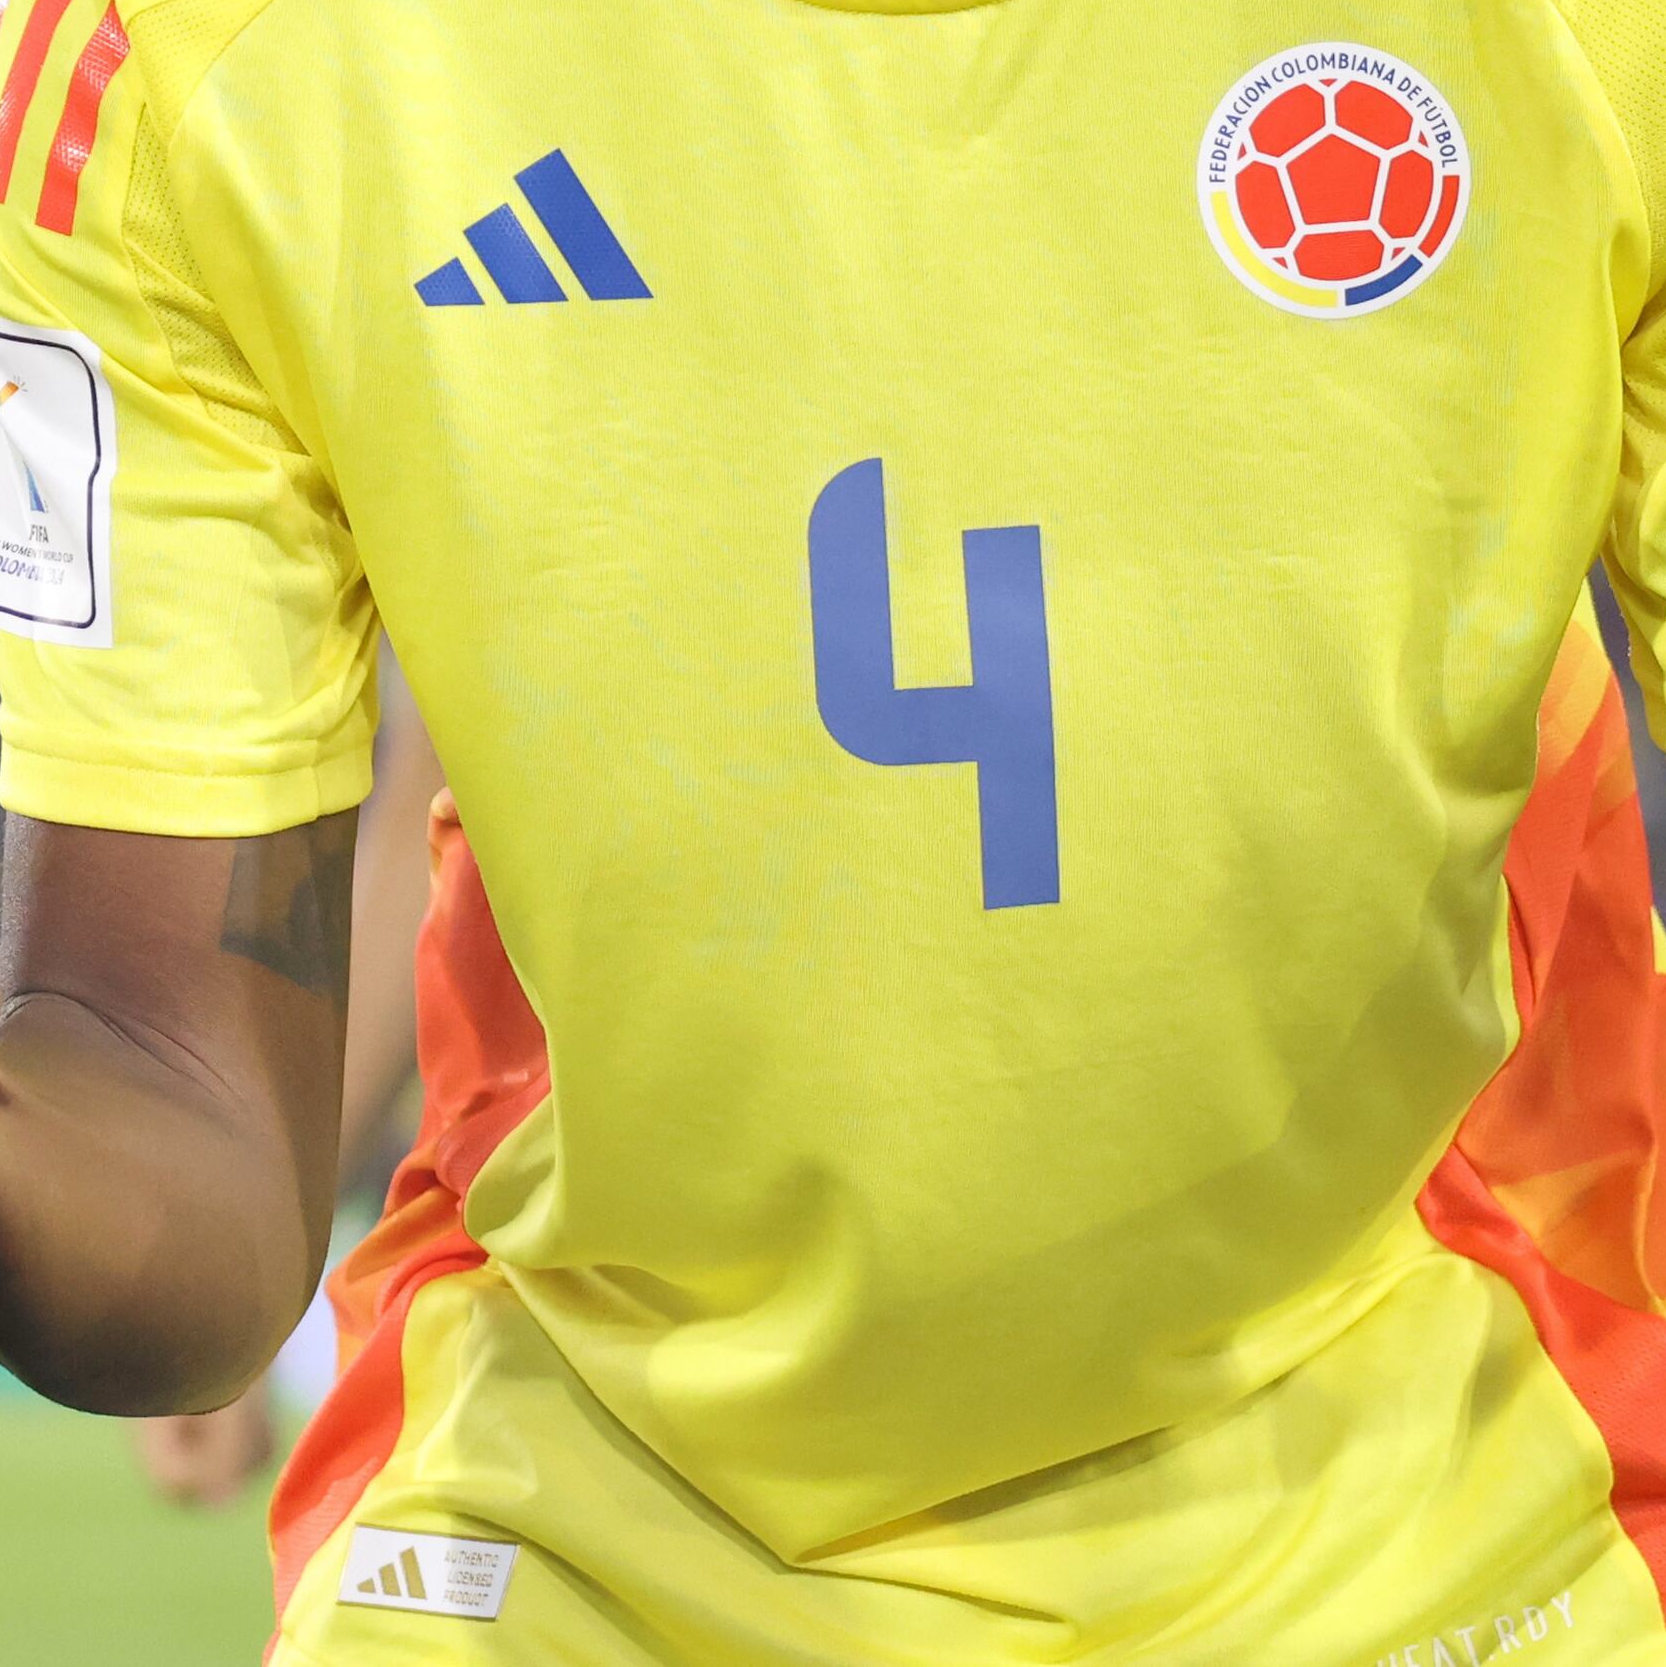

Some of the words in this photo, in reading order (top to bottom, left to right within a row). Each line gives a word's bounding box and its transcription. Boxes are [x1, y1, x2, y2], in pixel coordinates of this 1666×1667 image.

[1208, 74, 1273, 183] FEDERACIÓN
[1270, 51, 1396, 86] COLOMBIANA
[1396, 76, 1422, 102] DE
[1415, 96, 1459, 169] FÚTBOL
[28, 523, 50, 544] FIFA
[808, 457, 1060, 910] 4
[444, 1549, 499, 1568] AUTHENTIC
[444, 1589, 489, 1607] PRODUCT
